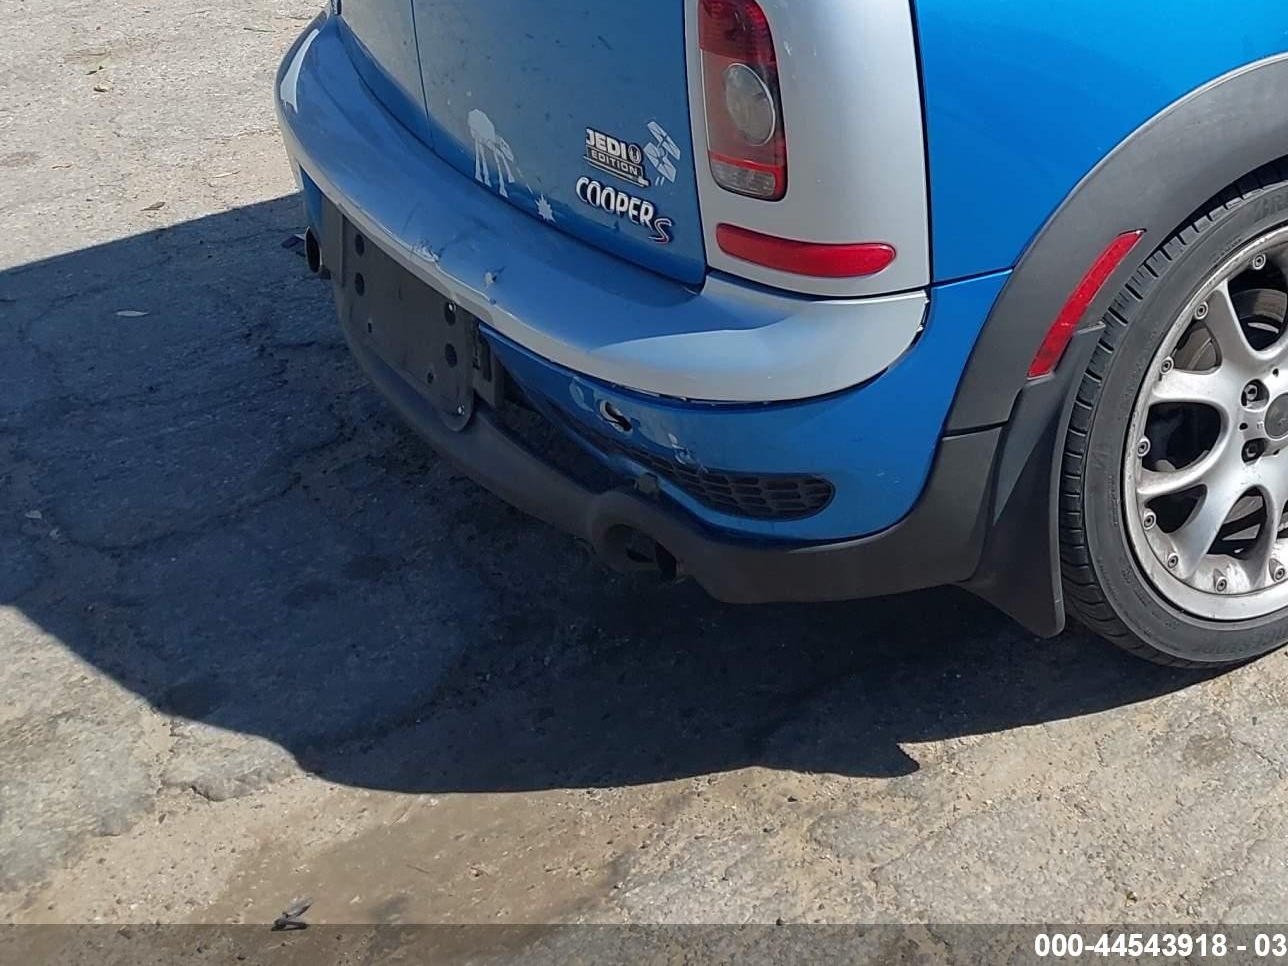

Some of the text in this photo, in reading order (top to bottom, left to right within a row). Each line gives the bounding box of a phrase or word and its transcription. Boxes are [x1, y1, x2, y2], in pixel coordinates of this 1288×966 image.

[586, 128, 628, 161] JEDI
[590, 149, 639, 176] EDITION
[575, 176, 673, 244] COOPER S
